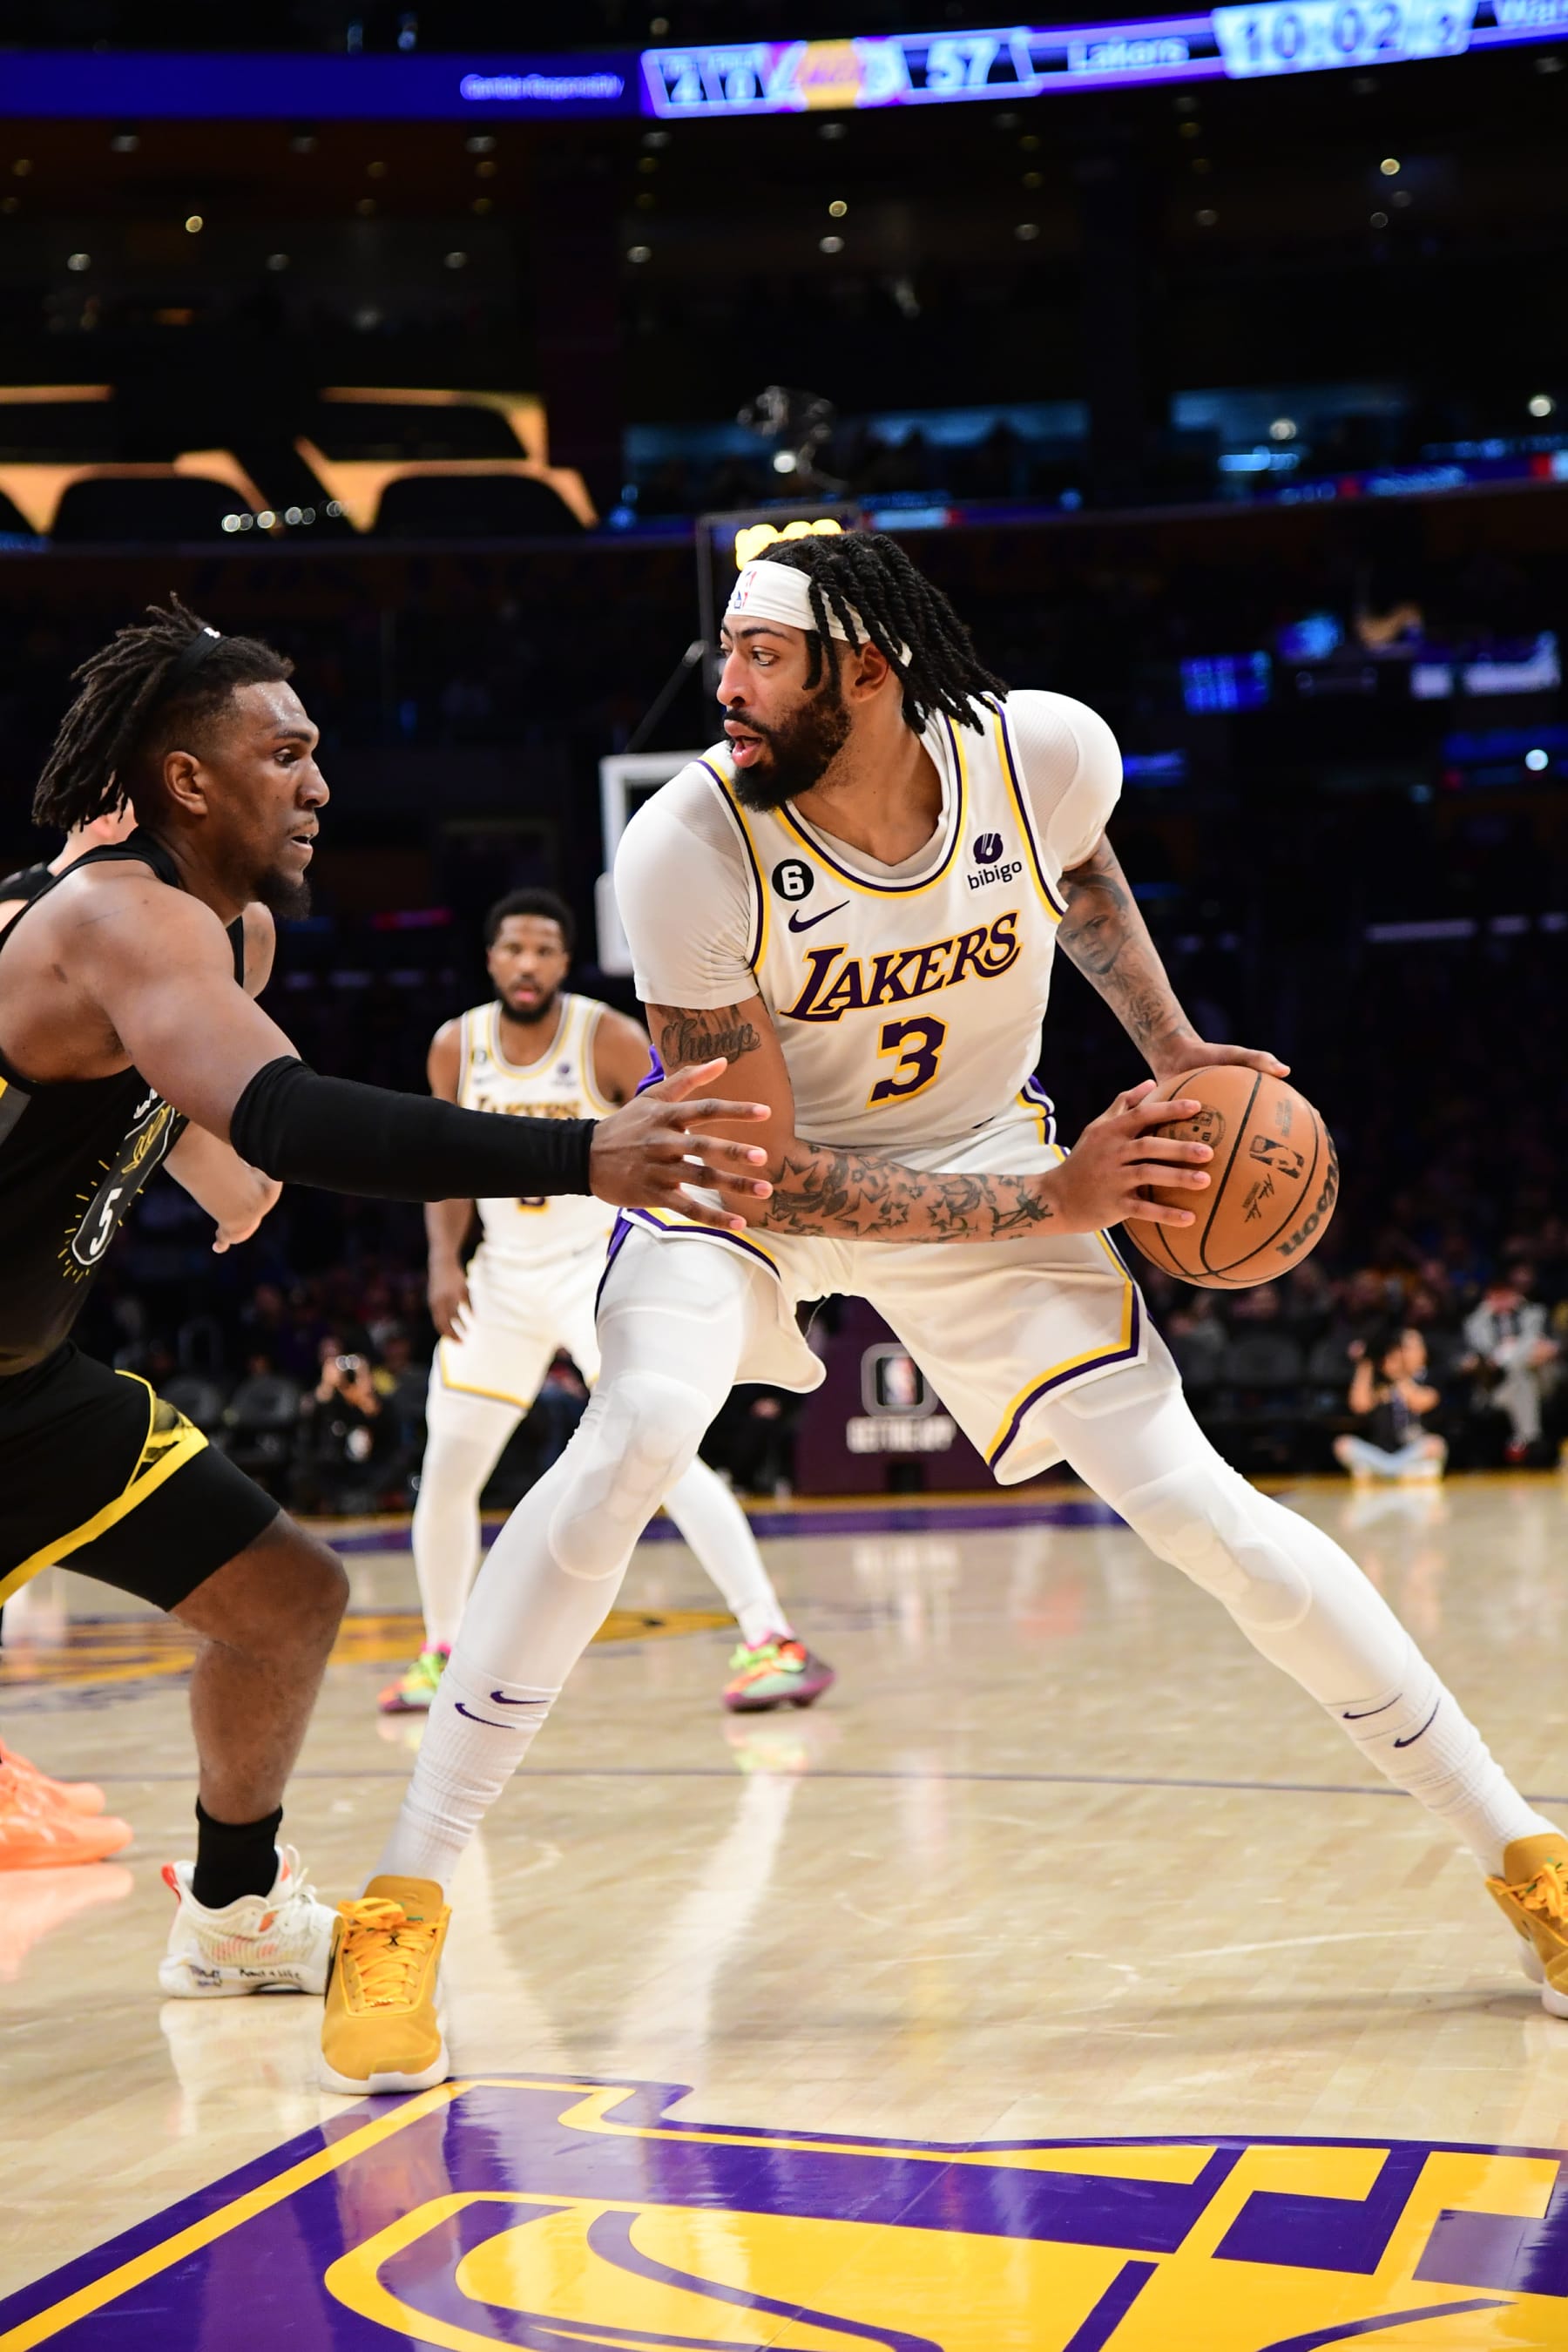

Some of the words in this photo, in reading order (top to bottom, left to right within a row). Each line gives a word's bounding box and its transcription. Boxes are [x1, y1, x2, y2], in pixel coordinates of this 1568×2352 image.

[925, 36, 1000, 95] 57
[781, 865, 806, 897] 6
[967, 861, 1023, 890] bibigo
[776, 909, 1024, 1024] LAKERS
[865, 1011, 950, 1110] 3
[88, 1186, 124, 1257] 5
